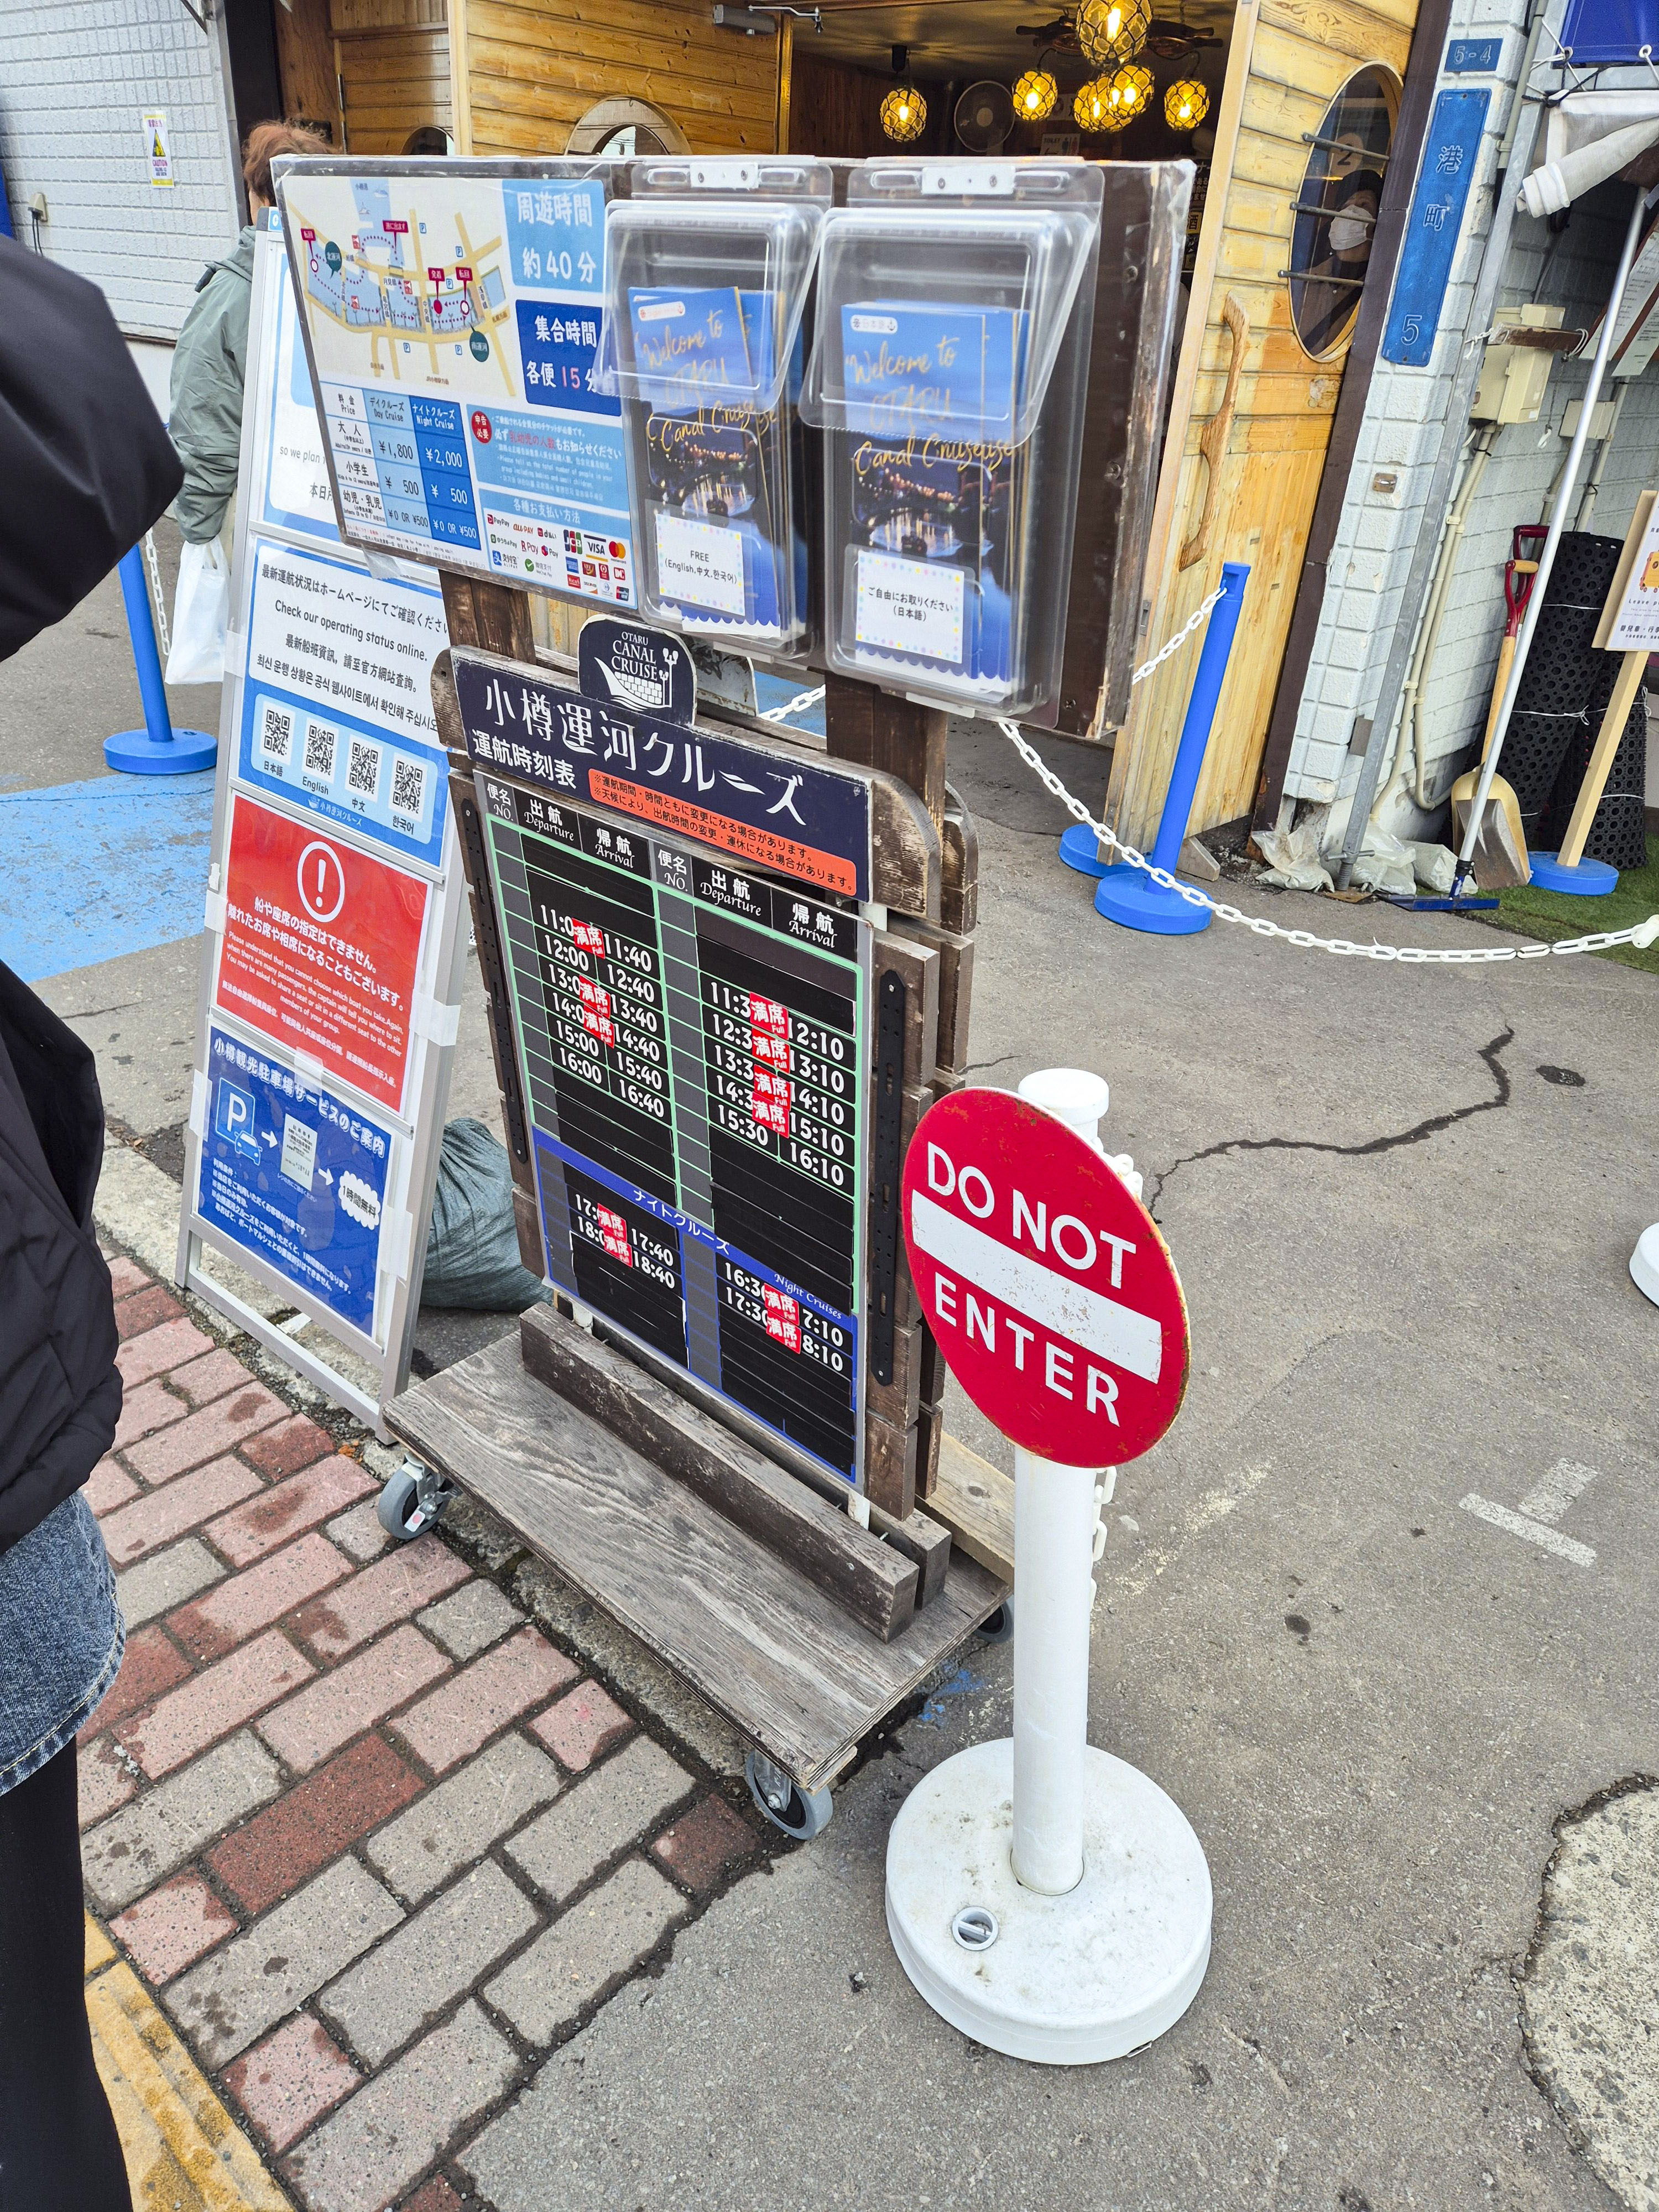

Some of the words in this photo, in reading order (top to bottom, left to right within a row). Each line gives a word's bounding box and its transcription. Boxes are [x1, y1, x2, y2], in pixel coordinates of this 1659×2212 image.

[517, 192, 592, 227] 周遊時間
[535, 315, 597, 348] 集合時間
[641, 325, 706, 368] Welcome
[707, 309, 723, 338] to
[1400, 314, 1422, 346] 5
[846, 340, 932, 384] Welcome
[937, 336, 959, 367] to
[341, 404, 355, 415] Price
[374, 408, 383, 419] Day
[385, 410, 404, 421] Cruise
[412, 404, 455, 419] ナイトクルーズ
[416, 415, 433, 427] Night
[435, 418, 455, 430] Cruise
[474, 415, 487, 426] 申告
[476, 428, 489, 440] 必要
[661, 406, 705, 452] Canal
[280, 446, 288, 456] so
[290, 448, 301, 458] we
[303, 449, 320, 464] plan
[379, 440, 413, 460] ¥1,800
[425, 447, 462, 468] ¥2,000
[855, 440, 915, 476] Canal
[346, 461, 369, 477] 小学生
[343, 489, 382, 510] 幼児・乳児
[403, 479, 419, 495] 500
[450, 488, 468, 504] 500
[388, 509, 399, 520] ¥0
[401, 512, 410, 523] OR
[413, 514, 429, 528] ¥500
[493, 517, 510, 527] PayPay
[513, 498, 580, 523] 各種お支払い方法
[433, 520, 445, 532] ¥0
[447, 522, 457, 534] OR
[460, 525, 477, 539] ¥500
[587, 541, 606, 555] VISA
[690, 550, 709, 562] FREE
[262, 564, 448, 634] 最新運航状況はホームページにてご確認ください
[868, 586, 953, 612] ご自由にお取りください
[893, 605, 927, 622] (日本語)
[275, 599, 302, 619] Check
[304, 611, 319, 624] our
[321, 615, 363, 642] operating
[366, 631, 395, 650] status
[397, 642, 427, 662] online.
[621, 631, 649, 646] OTARU
[612, 639, 656, 665] CANAL
[611, 655, 658, 681] CRUISE
[257, 654, 272, 670] 최신
[274, 659, 289, 676] 운행
[291, 665, 314, 686] 상황은
[315, 674, 330, 692] 공식
[332, 680, 379, 711] 웹사이트에서
[380, 698, 404, 721] 확인해
[472, 728, 577, 789] 運航時刻表
[486, 679, 806, 826] 小樽運河クルーズ
[264, 760, 284, 776] 日本語
[302, 776, 328, 795] English
[487, 782, 511, 806] 便名
[352, 797, 365, 812] 中文
[530, 799, 563, 827] 出航
[393, 815, 414, 835] 한국어
[523, 811, 575, 842] Departure
[594, 844, 635, 869] Arrival
[596, 827, 633, 857] 帰航
[658, 849, 687, 875] 便名
[700, 881, 762, 917] Departure
[711, 869, 751, 901] 出航
[540, 904, 574, 937] 11:0
[792, 902, 834, 936] 帰航
[228, 930, 244, 945] Please
[245, 938, 273, 960] understand
[254, 896, 377, 973] 船や座席の指定はできません。
[573, 925, 603, 947] 満席
[789, 920, 838, 949] Arrival
[545, 935, 589, 971] 12:00
[591, 946, 603, 955] Full
[604, 933, 652, 972] 11:40
[549, 963, 581, 996] 13:0
[580, 982, 608, 1006] 満席
[607, 964, 654, 1003] 12:40
[280, 995, 303, 1013] members
[317, 992, 337, 1009] captain
[553, 993, 585, 1024] 14:0
[611, 994, 658, 1032] 13:40
[711, 982, 751, 1018] 11:3
[751, 1000, 786, 1026] 満席
[333, 1013, 357, 1031] different
[584, 1012, 613, 1036] 満席
[713, 1014, 753, 1050] 12:3
[771, 1024, 785, 1035] Full
[556, 1020, 599, 1057] 15:00
[614, 1023, 660, 1062] 14:40
[753, 1036, 787, 1060] 満席
[788, 1018, 844, 1061] 12:10
[560, 1047, 602, 1084] 16:00
[617, 1051, 662, 1090] 15:40
[714, 1045, 754, 1081] 13:3
[774, 1059, 787, 1070] Full
[790, 1050, 844, 1093] 13:10
[213, 1037, 385, 1159] 小樽観光駐車場サービスのご案内
[619, 1079, 664, 1118] 16:40
[716, 1074, 753, 1110] 14:3
[754, 1072, 789, 1098] 満席
[753, 1099, 786, 1124] 満席
[774, 1096, 787, 1107] Full
[790, 1081, 844, 1125] 14:10
[718, 1104, 769, 1146] 15:30
[772, 1123, 785, 1133] Full
[790, 1112, 844, 1156] 15:10
[790, 1141, 844, 1186] 16:10
[342, 1185, 377, 1218] 1時間無料
[927, 1141, 995, 1218] DO
[1012, 1188, 1137, 1290] NOT
[633, 1189, 729, 1255] ナイトクルーズ
[631, 1228, 674, 1267] 17:40
[633, 1250, 675, 1289] 18:40
[765, 1289, 796, 1314] 満席
[774, 1274, 803, 1297] Night
[806, 1293, 842, 1319] Cruises
[767, 1316, 797, 1342] 満席
[784, 1311, 796, 1321] Full
[802, 1308, 843, 1347] 7:10
[785, 1339, 797, 1349] Full
[802, 1334, 843, 1372] 8:10
[935, 1271, 1121, 1428] ENTER
